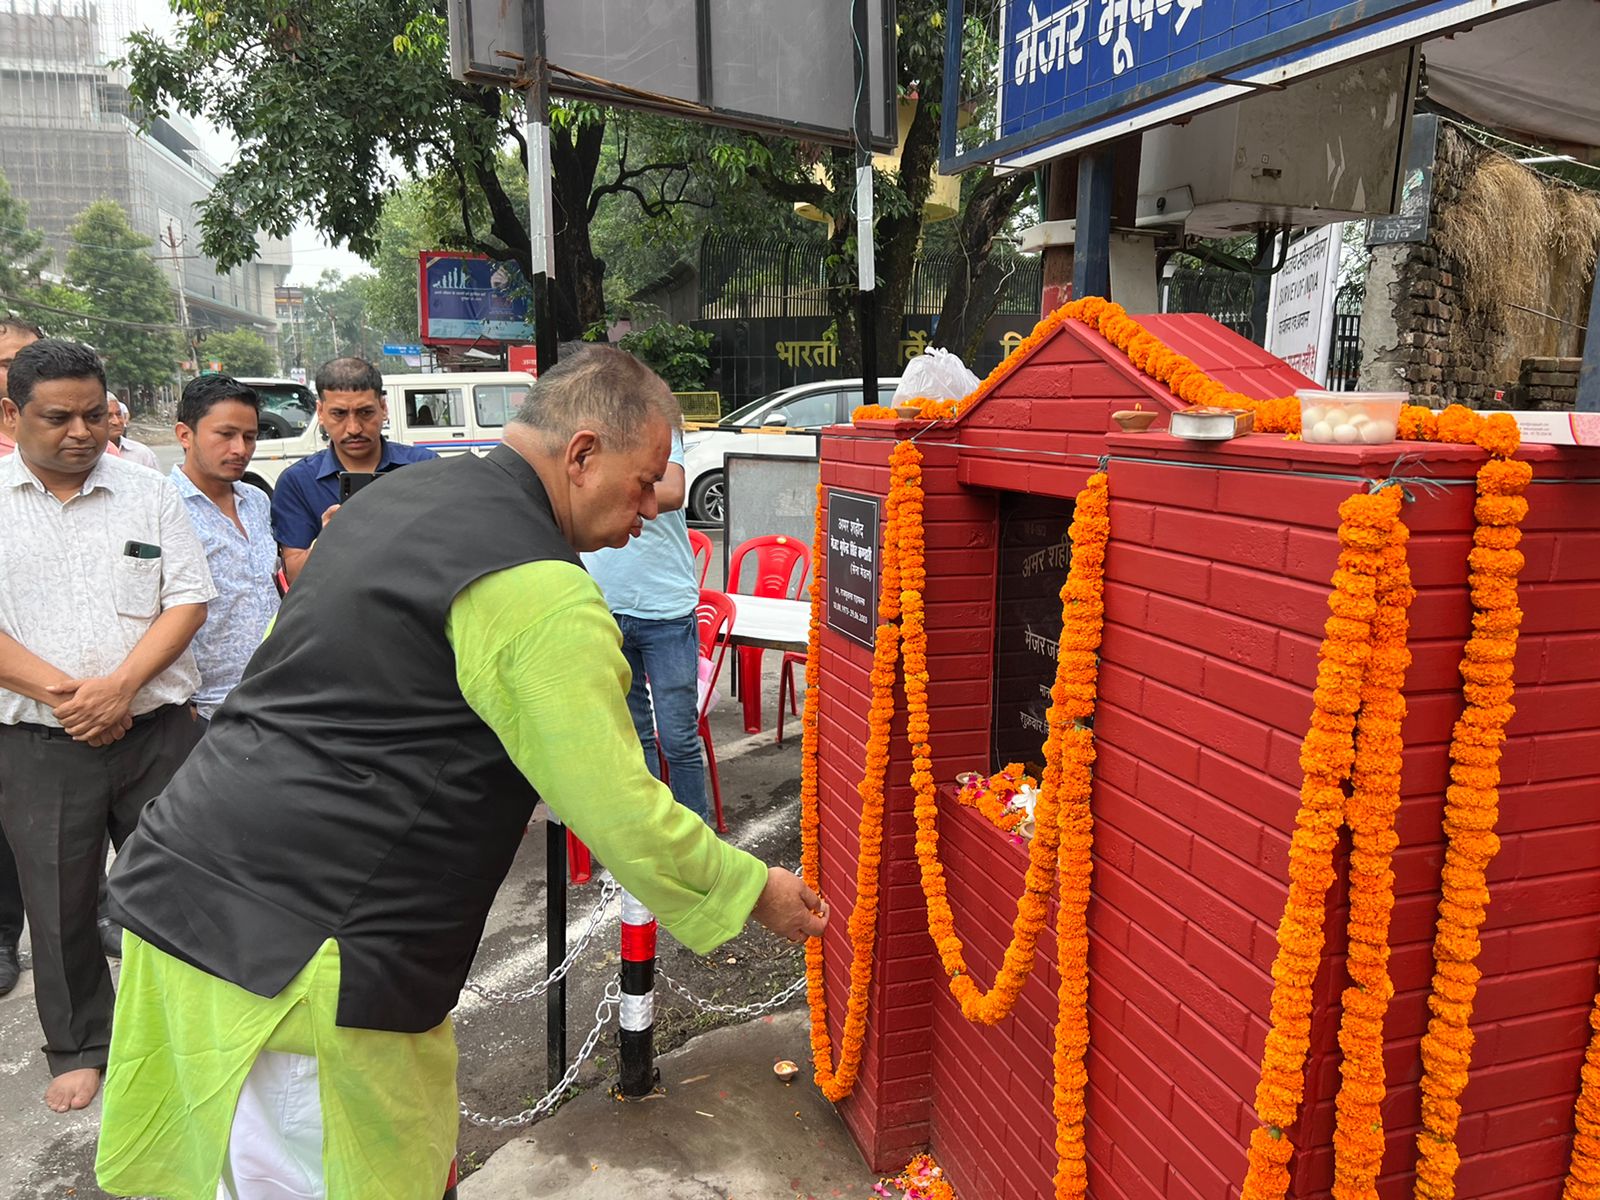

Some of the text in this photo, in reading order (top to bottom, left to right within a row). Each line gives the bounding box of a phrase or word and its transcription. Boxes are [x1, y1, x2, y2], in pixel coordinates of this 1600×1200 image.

[1015, 0, 1089, 86] मेजर
[1279, 281, 1299, 306] SURVEY
[1303, 271, 1319, 296] INDIA
[775, 332, 837, 368] भारती
[1022, 532, 1073, 578] अमर शही
[1024, 624, 1046, 655] मेजर
